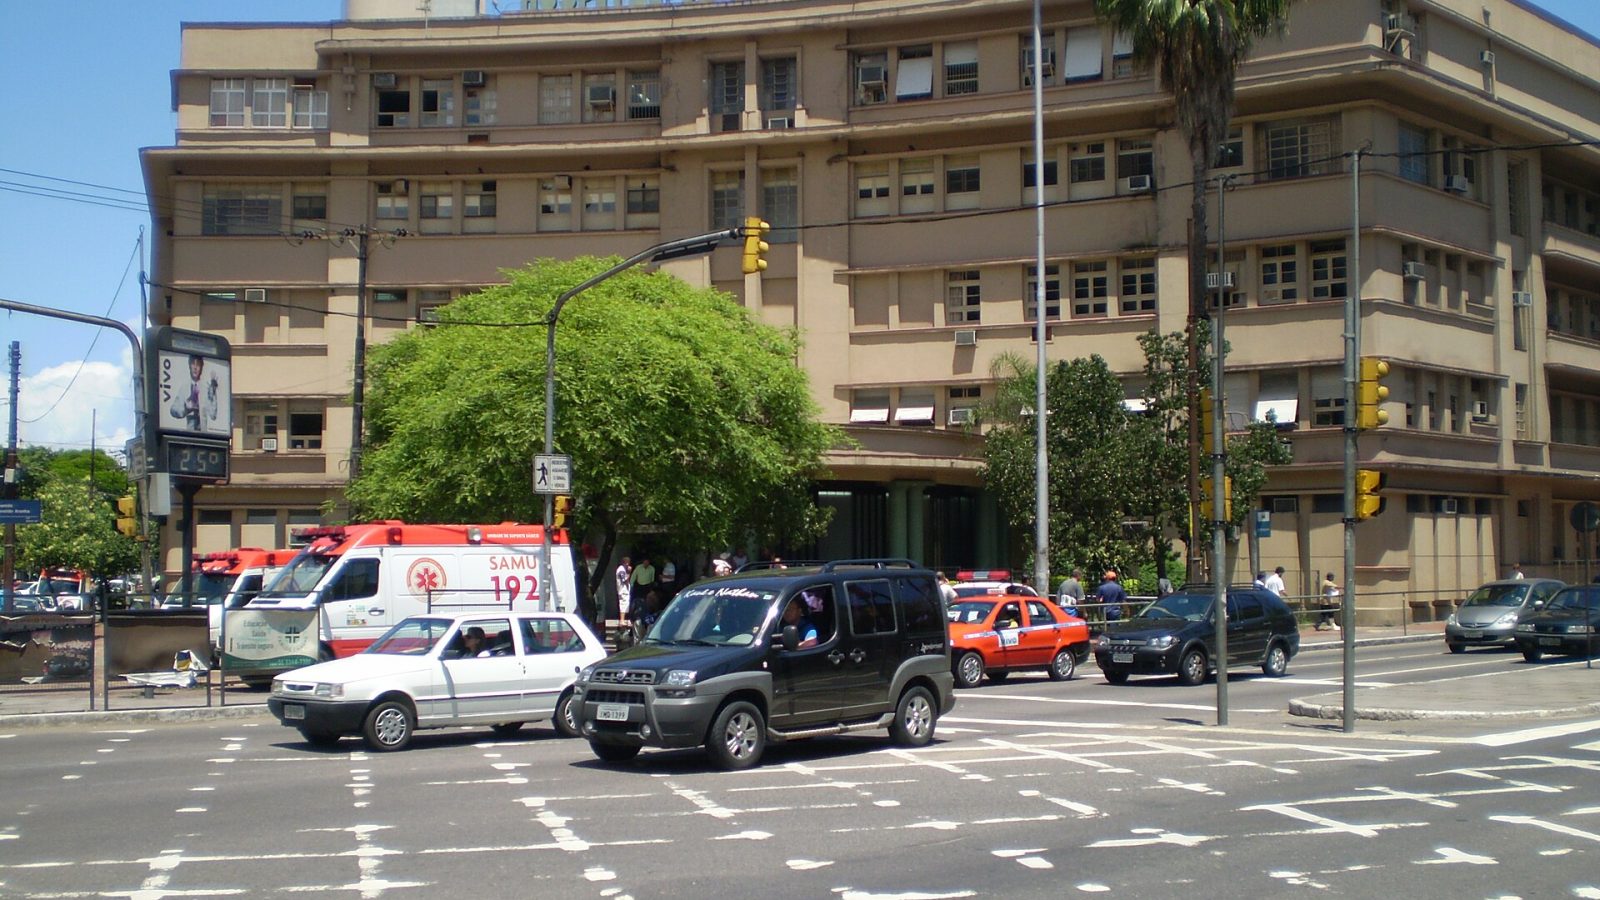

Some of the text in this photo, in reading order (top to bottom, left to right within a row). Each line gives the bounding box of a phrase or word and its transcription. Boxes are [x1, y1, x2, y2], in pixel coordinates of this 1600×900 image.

[160, 358, 171, 402] vivo
[489, 555, 537, 570] SAMU
[490, 575, 540, 601] 192
